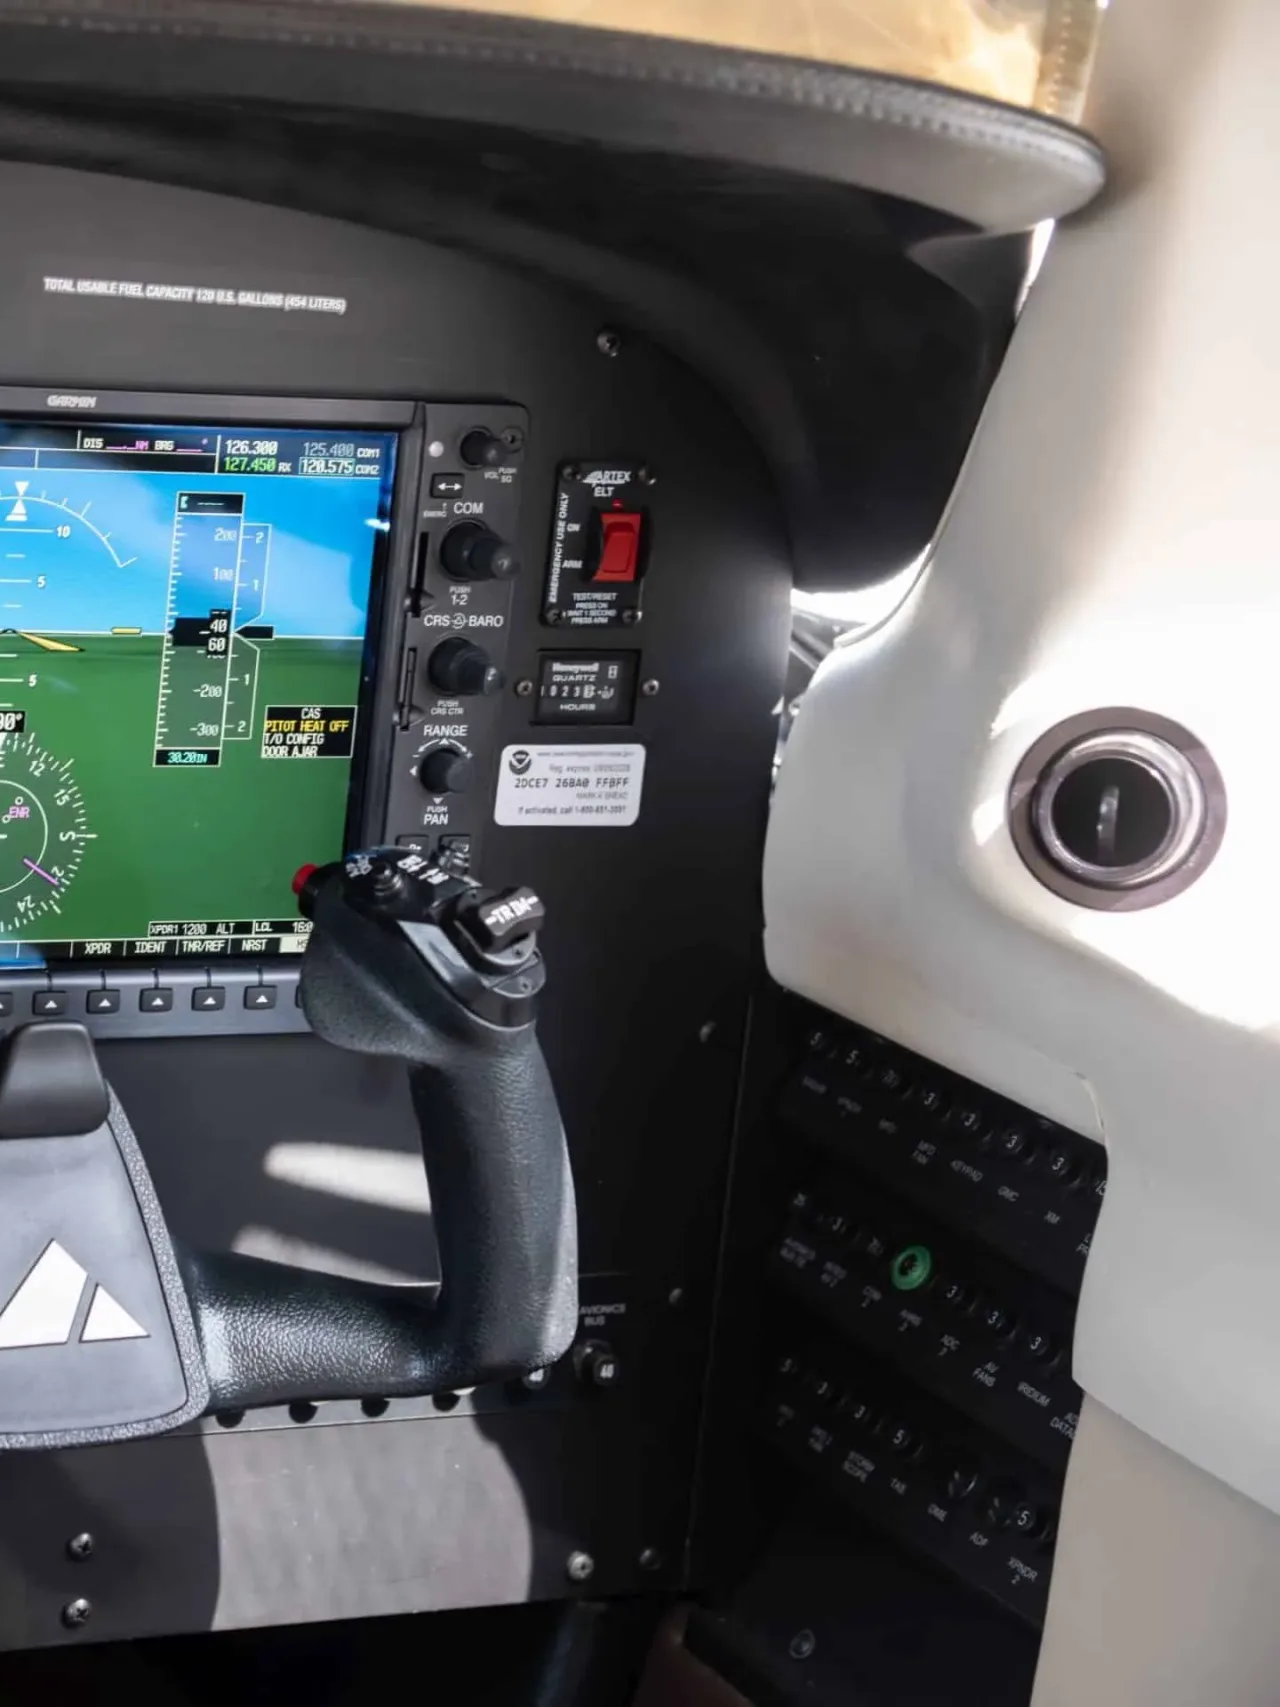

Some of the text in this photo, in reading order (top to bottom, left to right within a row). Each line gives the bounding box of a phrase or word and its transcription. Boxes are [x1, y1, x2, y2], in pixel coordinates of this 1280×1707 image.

[43, 277, 76, 292] TOTAL
[77, 278, 117, 295] USABLE
[119, 282, 144, 297] FUEL
[146, 284, 195, 301] CAPACITY
[196, 287, 215, 304] 120
[216, 289, 236, 305] U.S.
[237, 291, 283, 308] GALLONS
[308, 296, 347, 315] LITERS)
[224, 439, 278, 456] 126.300
[224, 456, 277, 473] 127.450
[302, 459, 353, 475] 120.575
[597, 471, 631, 482] ARTEX
[594, 486, 615, 497] ELT
[453, 502, 484, 514] COM
[548, 492, 569, 603] EMERGENCY USE ONLY
[451, 594, 468, 606] 1-2
[423, 615, 450, 627] CRS
[468, 616, 504, 628] BARO
[552, 674, 597, 682] QUARTZ
[301, 708, 321, 719] CAS
[265, 721, 349, 732] PITOT HEAT OFF
[423, 725, 468, 736] RANGE
[263, 746, 318, 758] DOOR AJAR
[423, 814, 449, 825] PAN
[85, 942, 111, 954] XPDR
[134, 941, 167, 953] IDENT
[242, 939, 269, 951] NRST
[1018, 1511, 1030, 1525] 5
